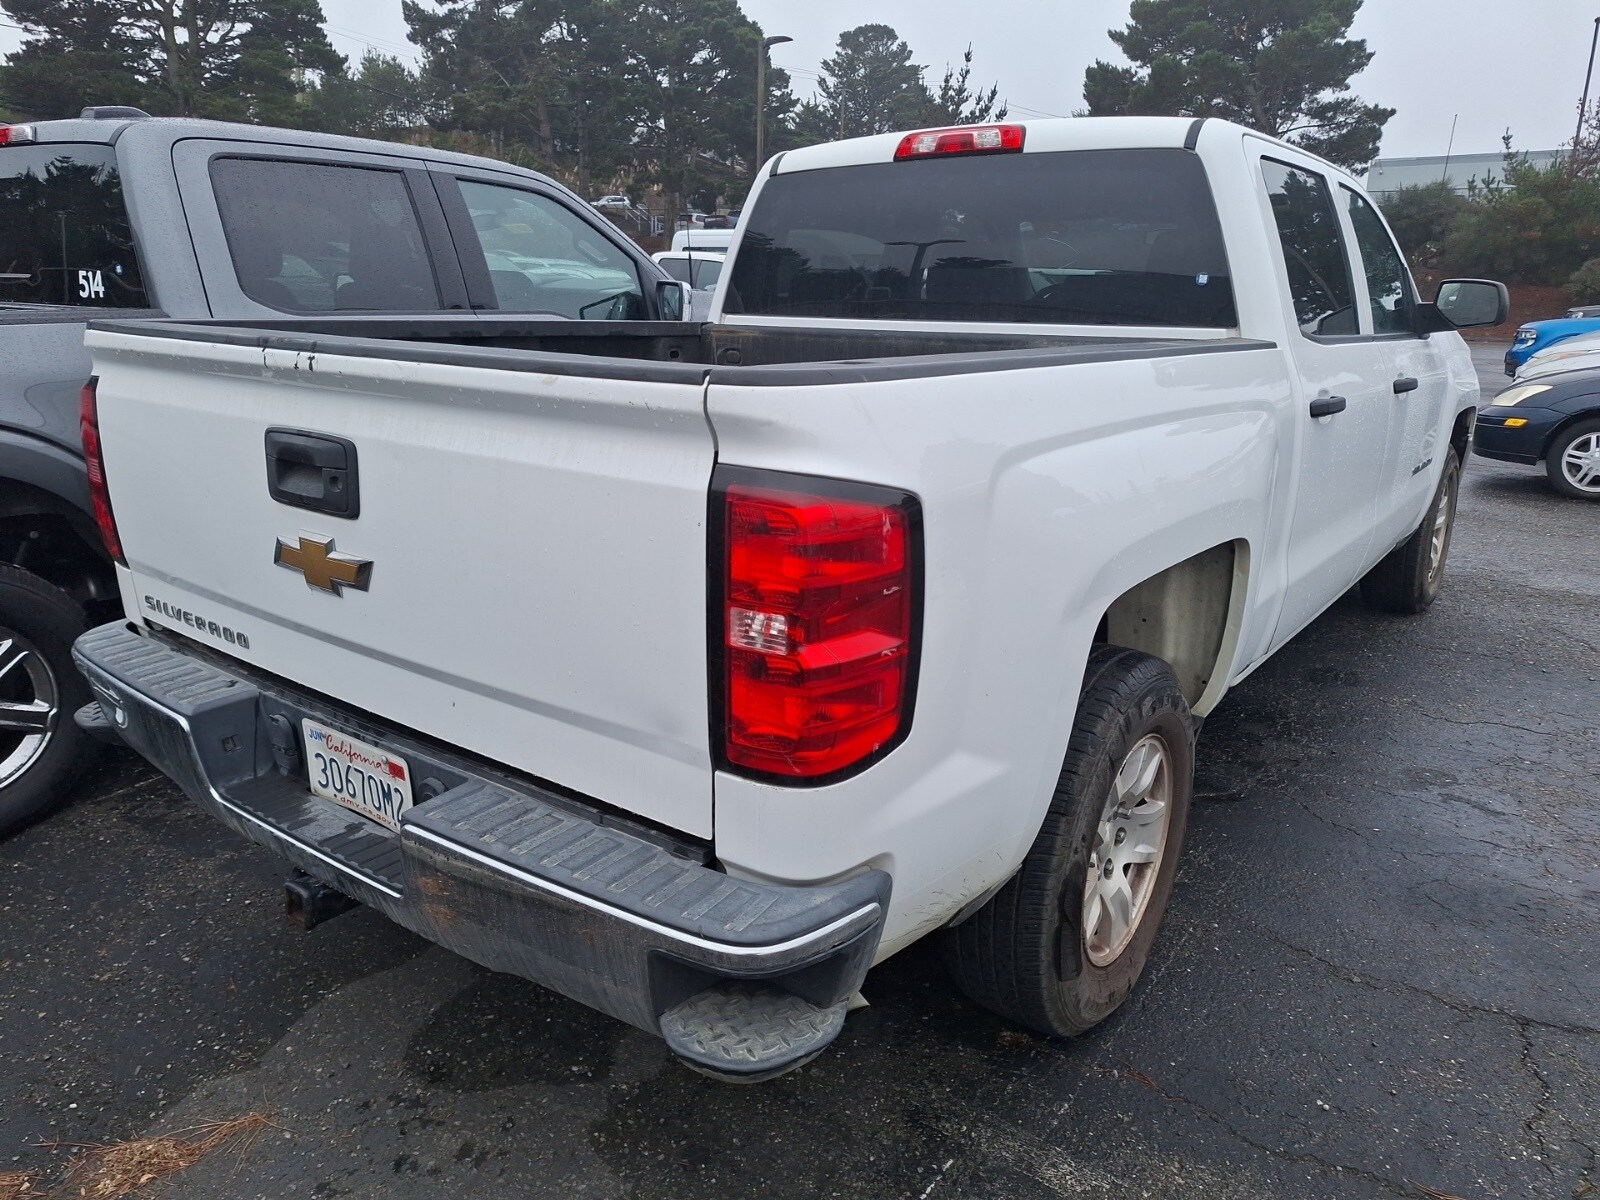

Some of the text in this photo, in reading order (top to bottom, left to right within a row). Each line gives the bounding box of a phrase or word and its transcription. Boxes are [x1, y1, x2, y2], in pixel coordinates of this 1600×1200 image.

[78, 270, 105, 298] 514
[144, 595, 250, 650] SILVERADO
[308, 728, 324, 742] JUN
[325, 734, 383, 769] California
[314, 752, 404, 823] 30670M2
[339, 797, 392, 825] dmv.ca.gov
